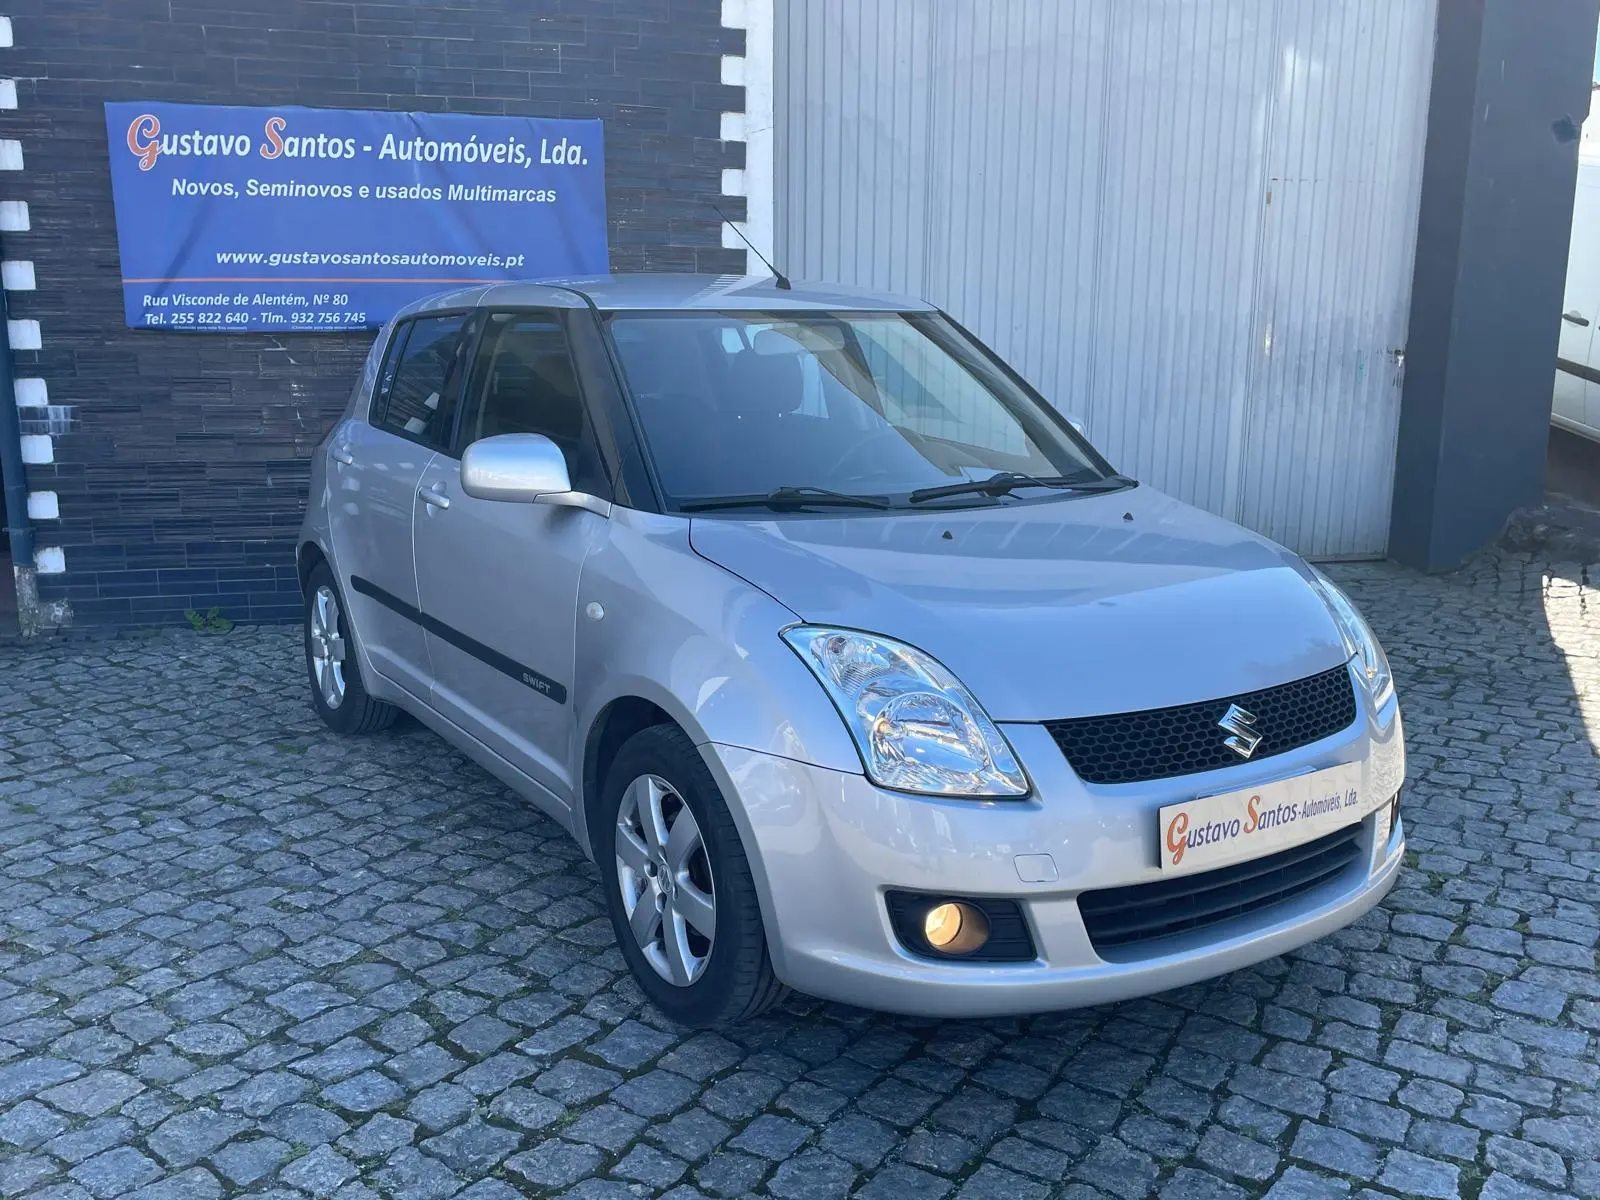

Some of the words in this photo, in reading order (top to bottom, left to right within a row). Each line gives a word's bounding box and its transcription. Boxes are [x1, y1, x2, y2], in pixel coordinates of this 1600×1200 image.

[127, 114, 250, 171] Gustavo
[260, 117, 355, 160] Santos
[378, 133, 532, 168] Automóveis,
[540, 138, 588, 165] Lda.
[172, 178, 239, 199] Novos,
[246, 179, 353, 198] Seminovos
[358, 186, 370, 198] e
[375, 183, 442, 200] usados
[448, 184, 556, 202] Multimarcas
[216, 251, 525, 269] www.gustavosantosautomoveis.pt
[143, 294, 169, 307] Rua
[172, 293, 230, 307] Visconde
[233, 293, 249, 306] de
[252, 293, 309, 308] Alentém,
[332, 294, 349, 306] 80
[145, 313, 167, 325] Tel.
[171, 312, 195, 325] 255
[198, 312, 221, 324] 822
[225, 312, 249, 324] 640
[260, 311, 287, 324] Tlm.
[291, 311, 314, 323] 932
[318, 311, 340, 323] 756
[344, 311, 366, 323] 745
[522, 672, 551, 694] SWIFT
[1166, 812, 1240, 865] Gustavo
